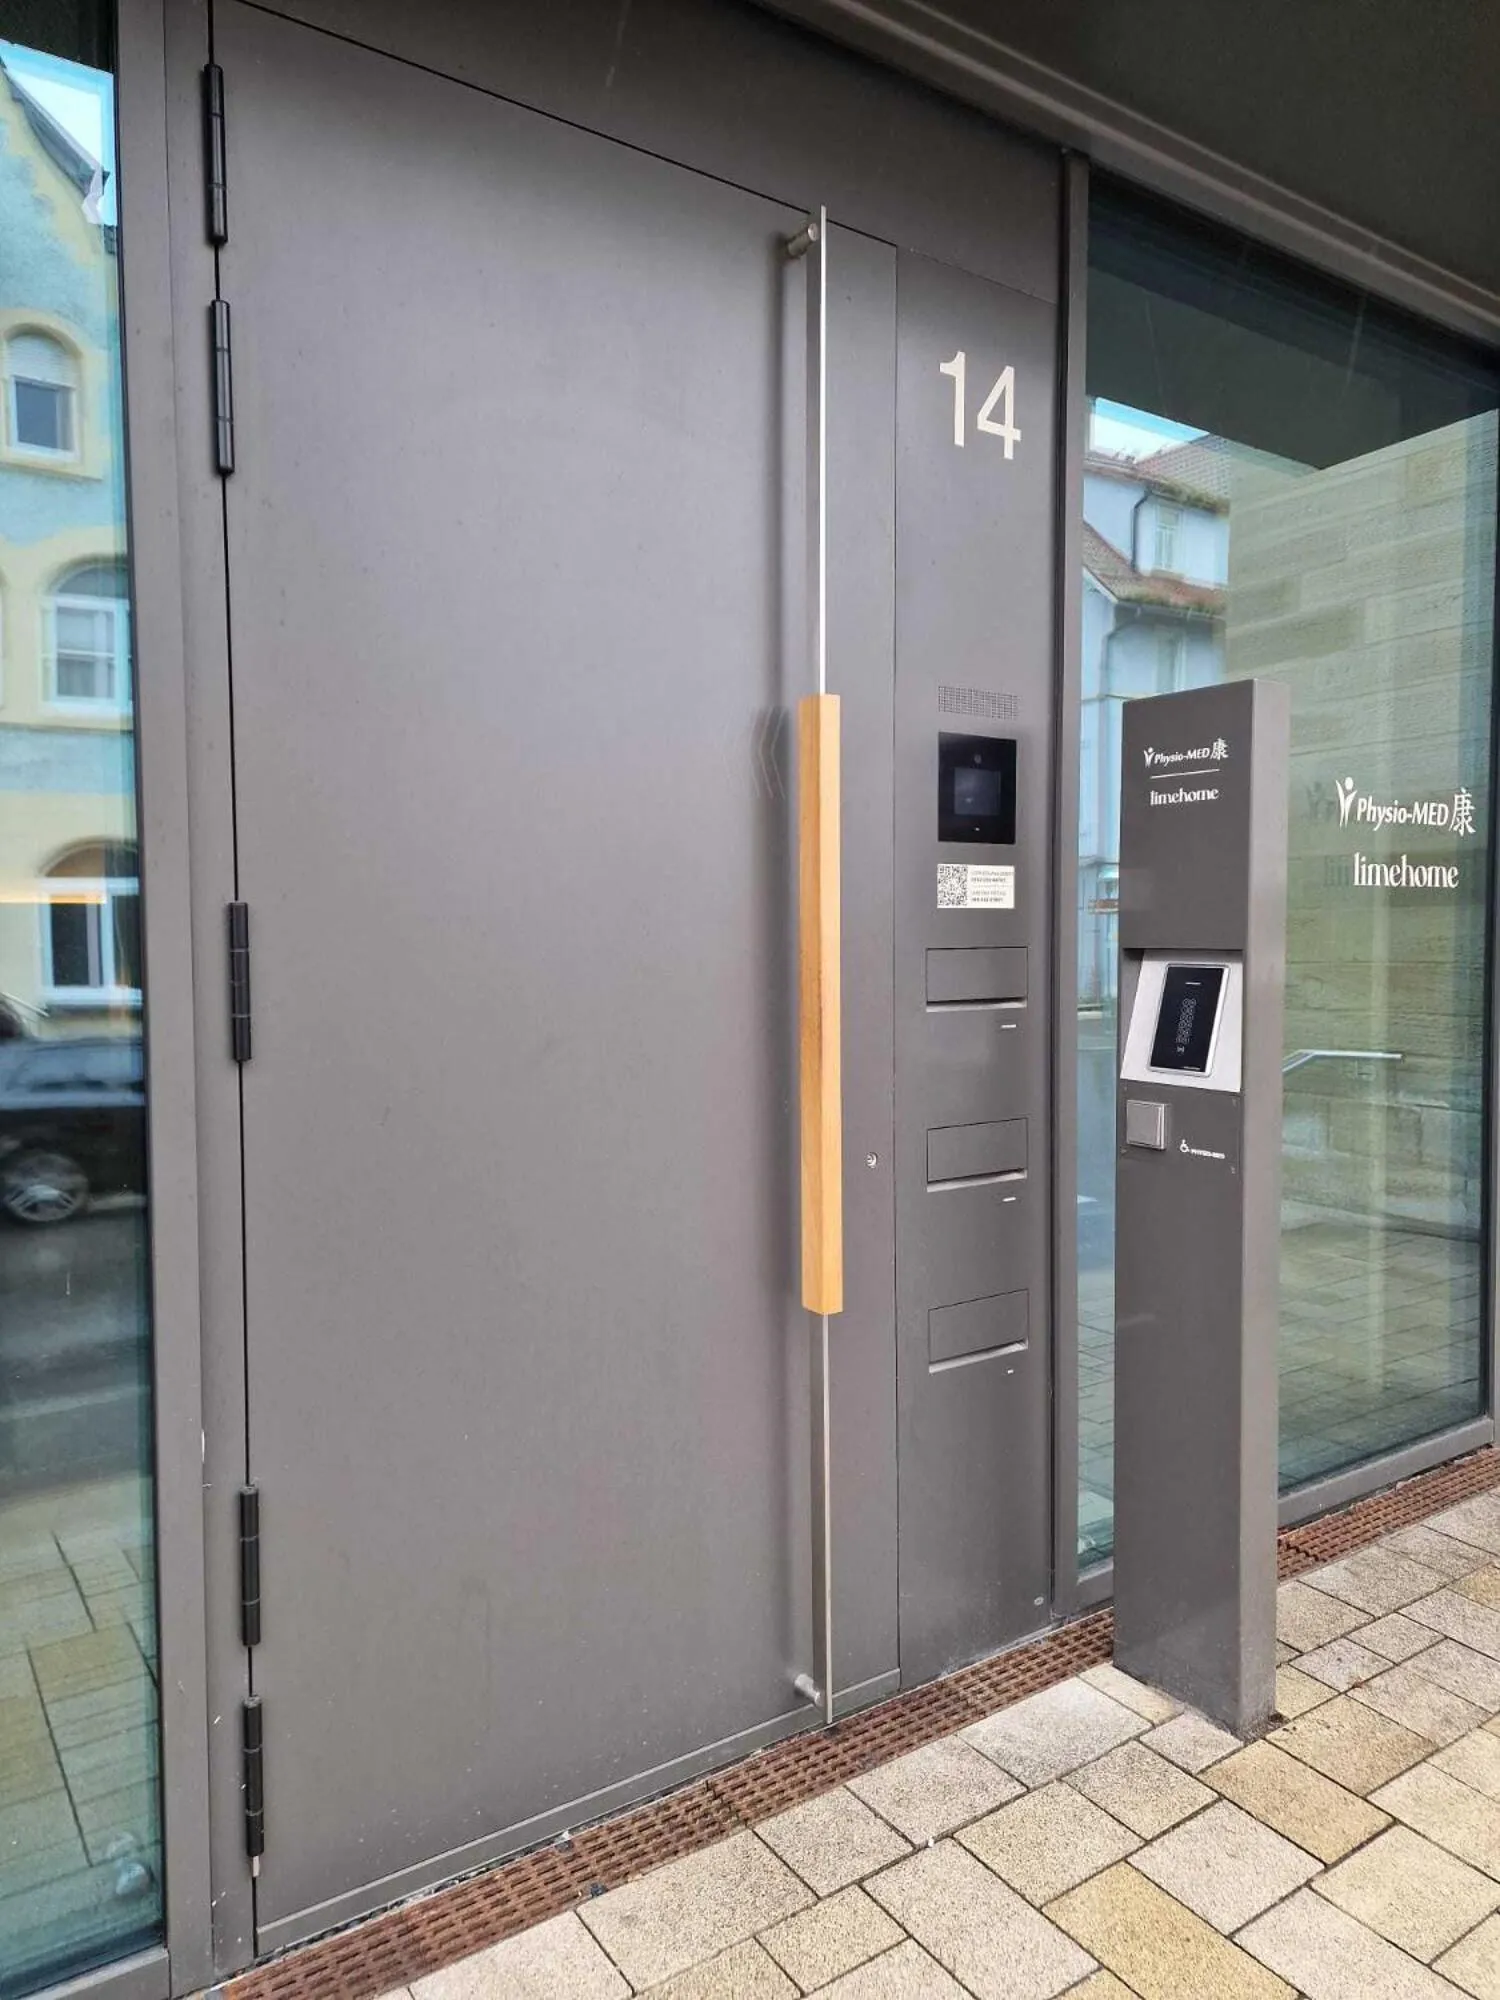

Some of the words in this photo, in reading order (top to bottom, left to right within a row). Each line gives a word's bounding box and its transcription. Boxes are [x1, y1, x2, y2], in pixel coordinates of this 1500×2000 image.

[939, 350, 1022, 460] 14
[1154, 747, 1210, 766] Physio-MED
[1150, 788, 1219, 806] limehome
[1356, 795, 1449, 832] Physio-MED
[1449, 787, 1477, 837] 康
[1353, 852, 1460, 888] limehome
